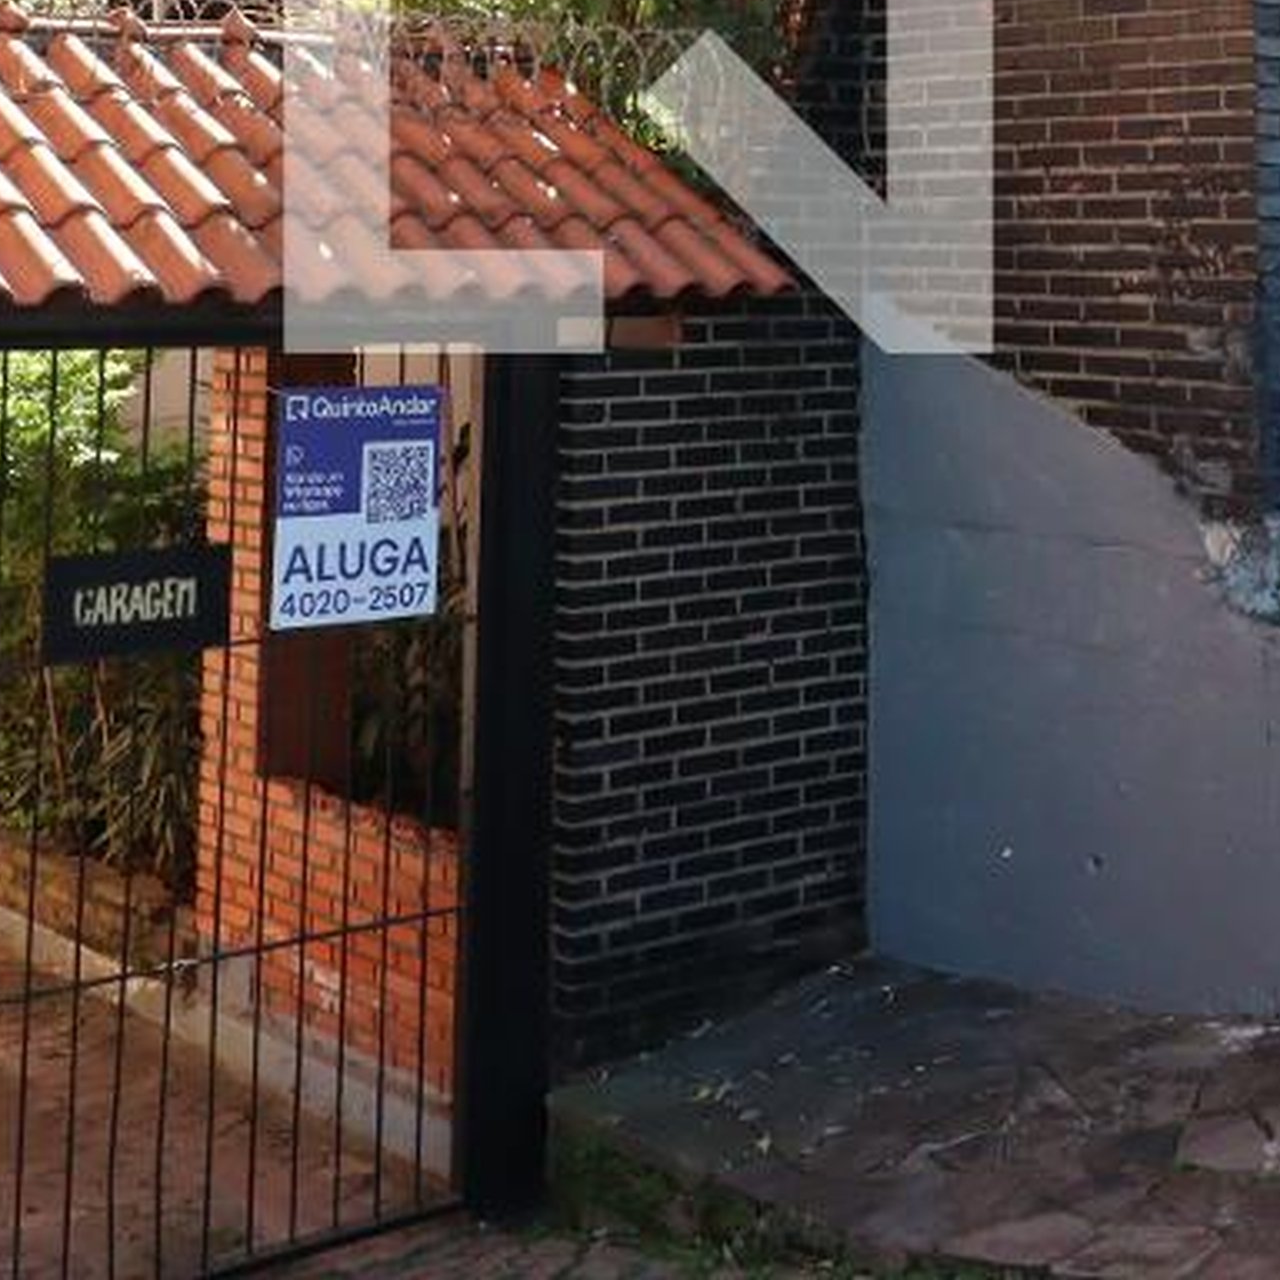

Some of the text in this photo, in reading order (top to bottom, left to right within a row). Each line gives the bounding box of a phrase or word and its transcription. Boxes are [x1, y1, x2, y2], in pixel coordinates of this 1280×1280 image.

[312, 395, 437, 419] QuintoAndar
[282, 536, 430, 583] ALUGA
[74, 577, 197, 625] GARAGEM
[279, 582, 429, 619] 4020-2507
